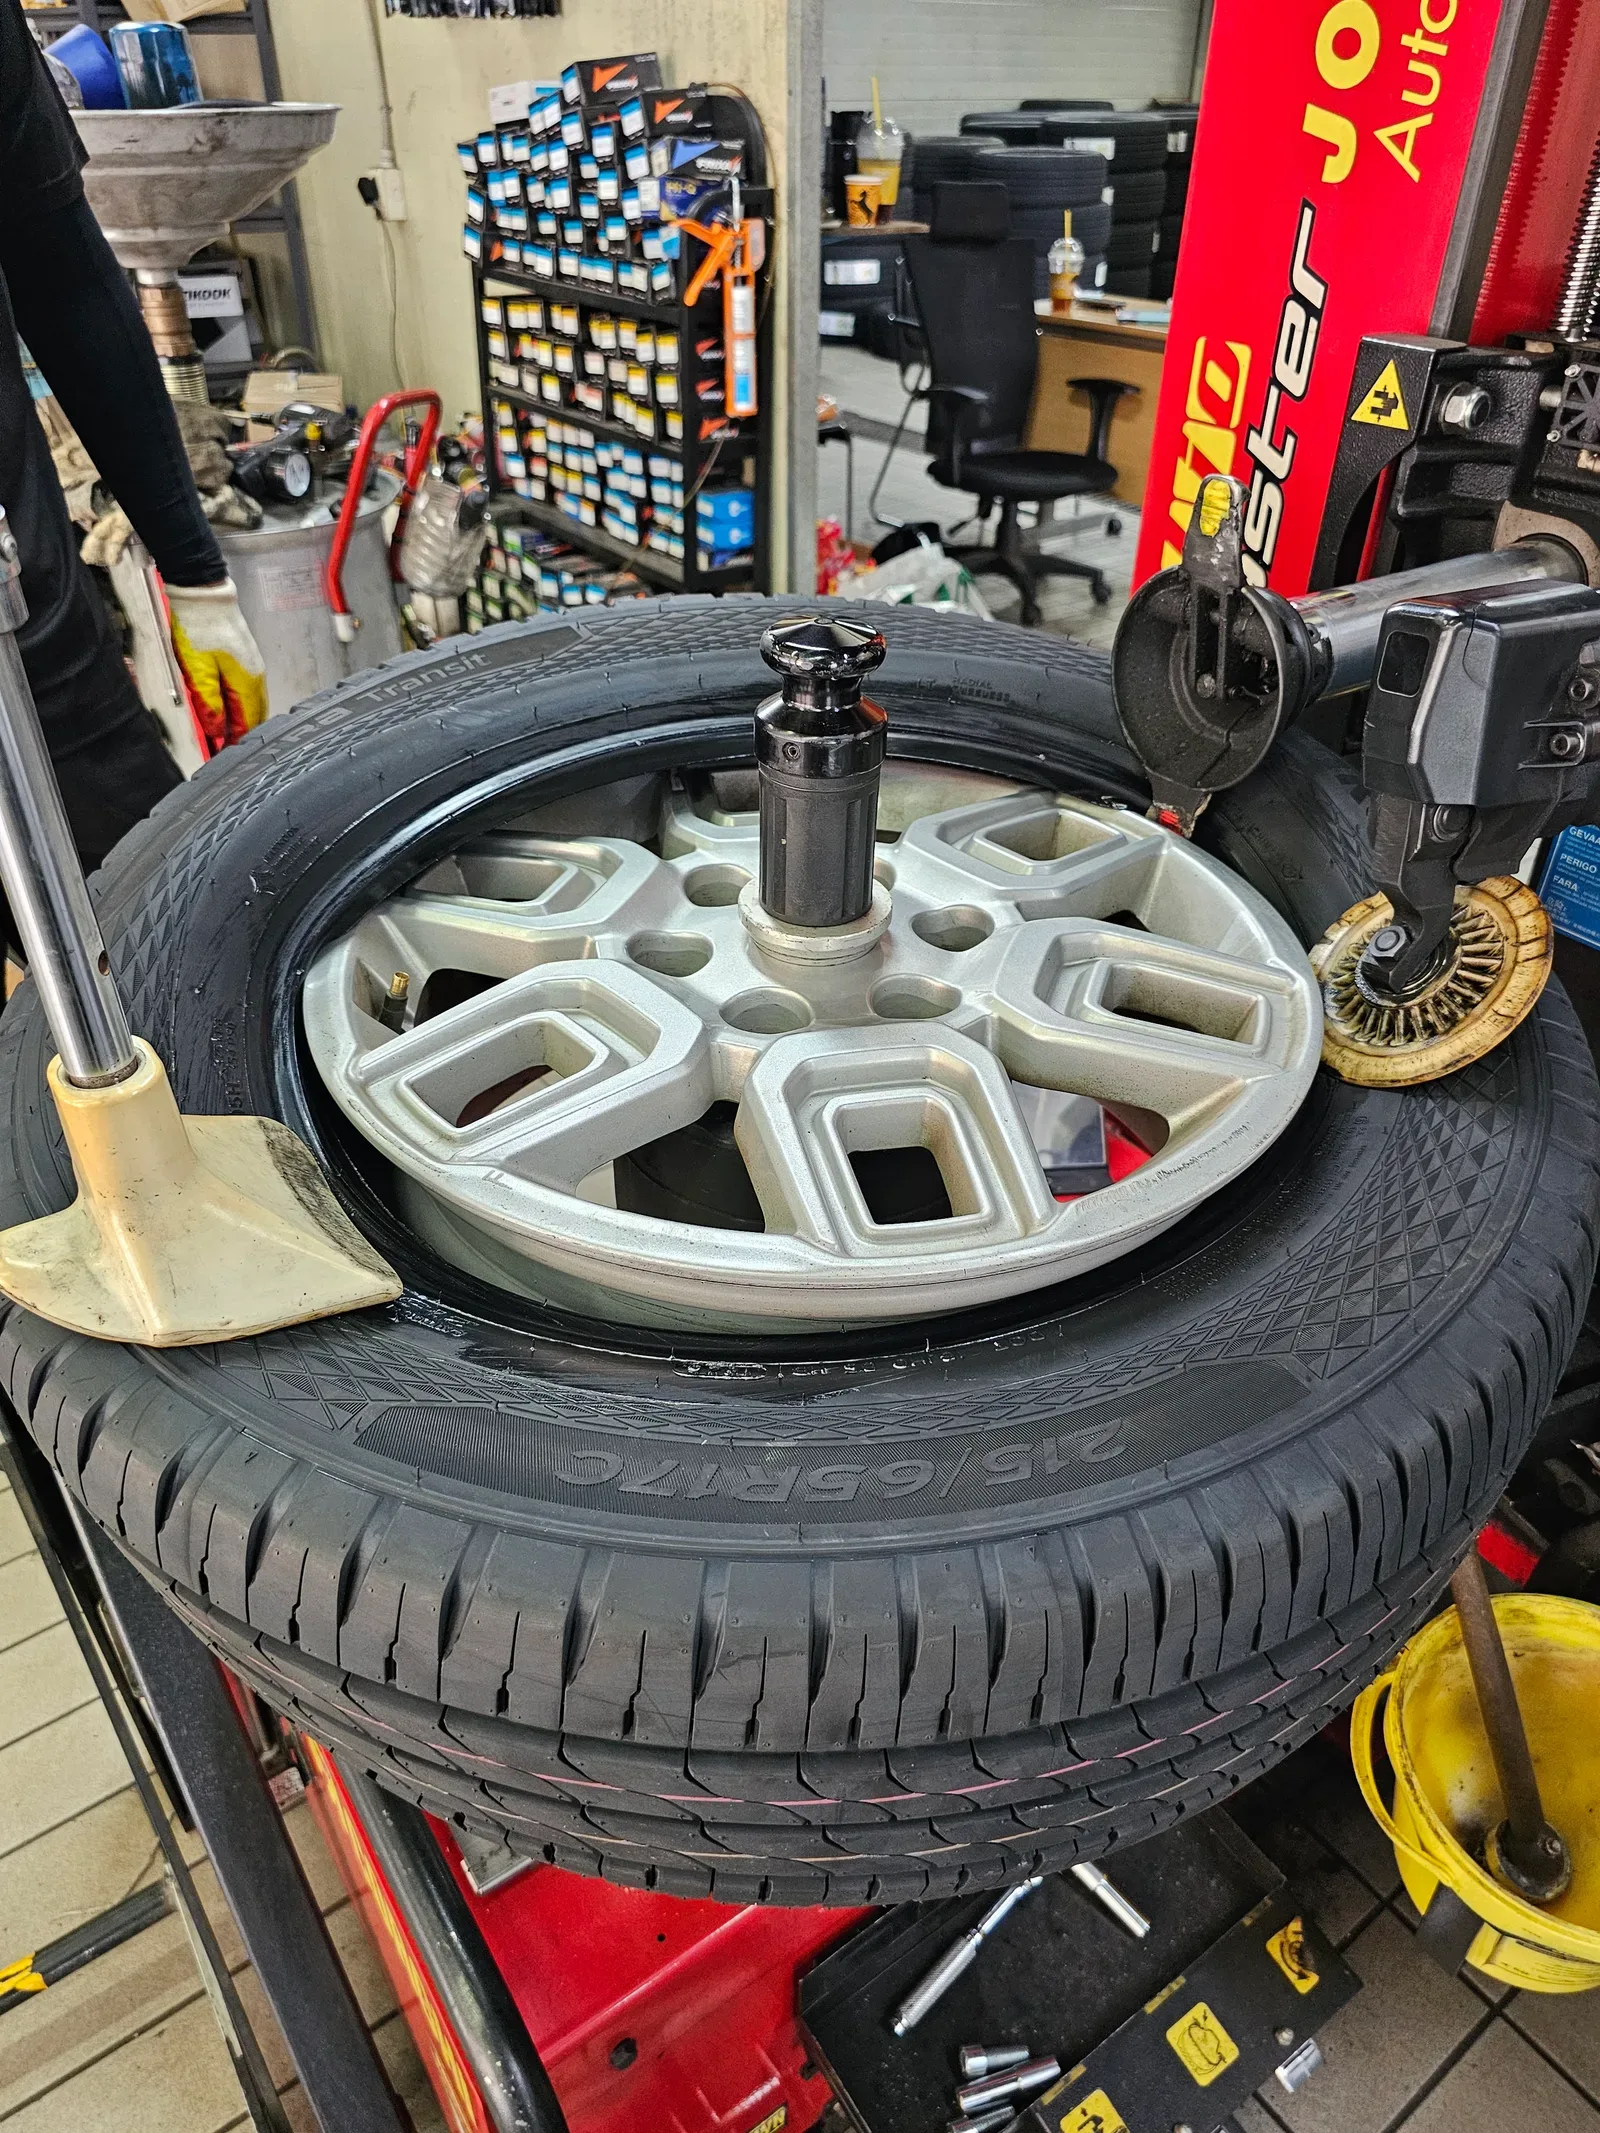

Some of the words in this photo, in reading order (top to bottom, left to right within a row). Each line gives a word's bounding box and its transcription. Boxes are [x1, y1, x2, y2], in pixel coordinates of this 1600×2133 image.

[356, 651, 492, 702] Transit
[1560, 853, 1598, 874] PERIGO
[554, 1416, 1129, 1502] 215/65R17C
